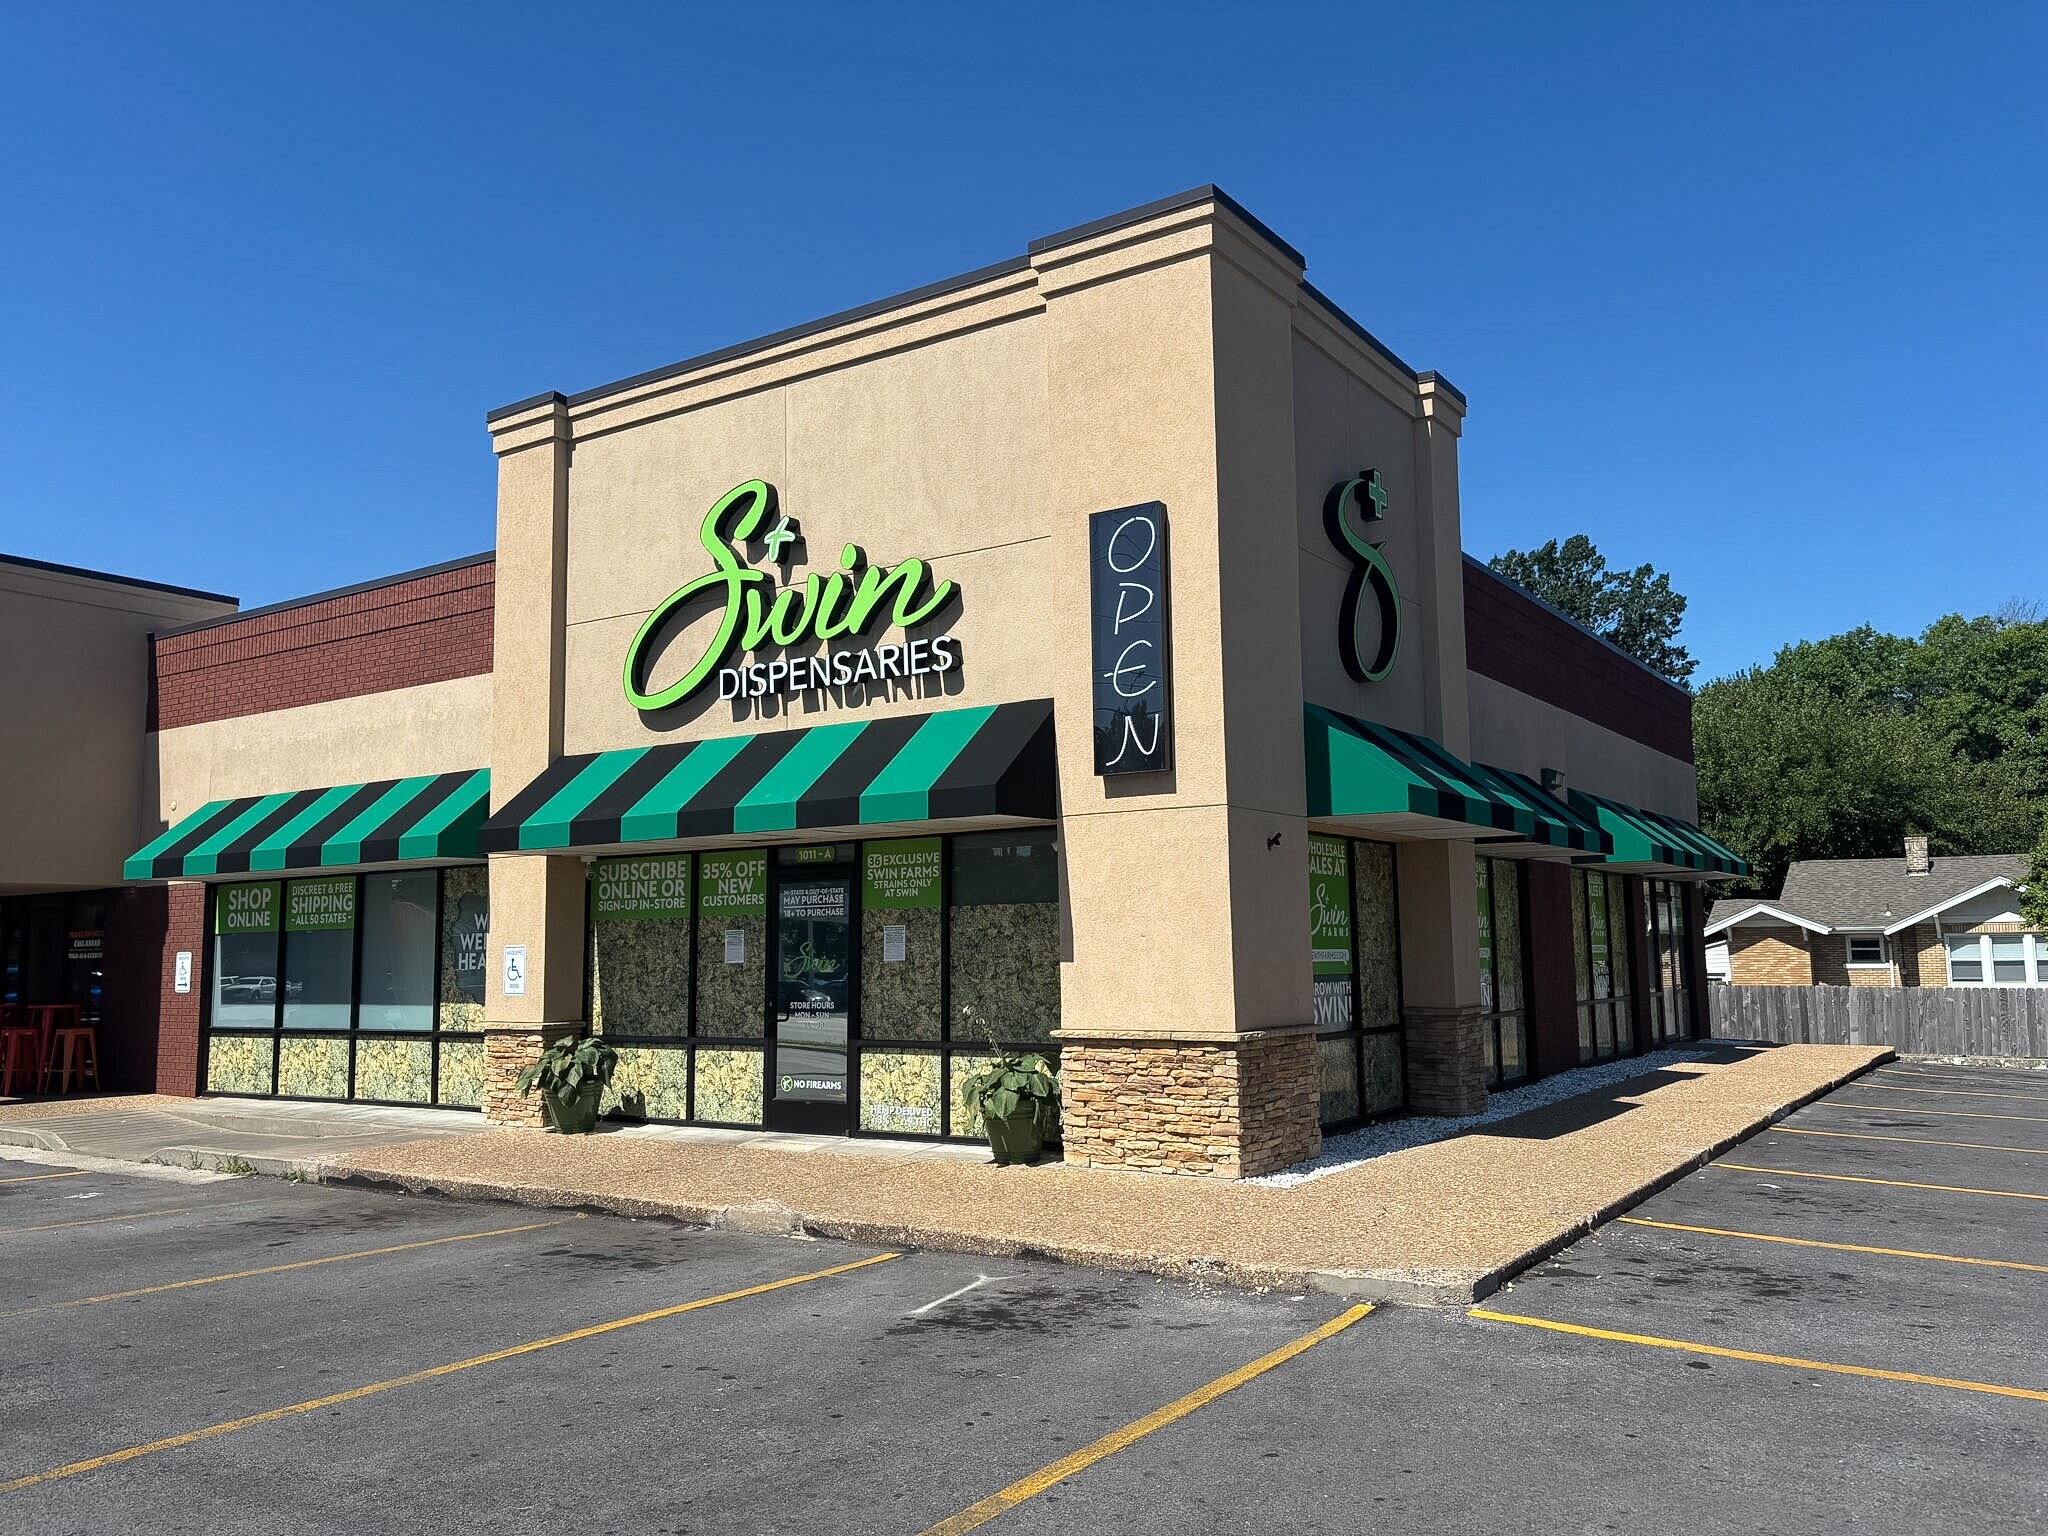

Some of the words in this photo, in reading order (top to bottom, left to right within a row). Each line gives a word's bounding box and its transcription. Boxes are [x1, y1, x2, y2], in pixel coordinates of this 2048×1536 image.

[623, 479, 954, 711] Swin
[1104, 516, 1159, 767] OPEN
[718, 635, 954, 701] DISPENSARIES
[799, 850, 817, 861] 1011
[824, 849, 832, 859] A
[1308, 841, 1345, 858] HOLESALE
[883, 852, 940, 866] EXCLUSIVE
[599, 860, 687, 882] SUBSCRIBE
[702, 862, 732, 880] 35%
[736, 860, 765, 877] OFF
[867, 868, 898, 880] SWIN
[900, 866, 940, 879] FARMS
[1310, 856, 1332, 875] ALES
[1334, 858, 1345, 877] AT
[292, 884, 327, 896] DISCREET
[335, 882, 353, 893] FREE
[598, 880, 657, 900] ONLINE
[661, 879, 686, 897] OR
[718, 877, 754, 895] NEW
[873, 879, 908, 889] STRAINS
[909, 878, 933, 888] ONLY
[228, 888, 272, 911] SHOP
[884, 889, 896, 898] AT
[896, 887, 919, 898] SWIN
[291, 893, 353, 915] SHIPPING
[598, 899, 637, 912] SIGN-UP
[639, 897, 686, 909] IN-STORE
[702, 894, 765, 907] CUSTOMERS
[783, 896, 801, 906] MAY
[801, 894, 844, 905] PURCHASE
[227, 911, 271, 928] ONLINE
[295, 914, 309, 926] ALL
[309, 914, 319, 925] 50
[319, 912, 347, 924] STATES
[783, 910, 796, 918] 18+
[796, 909, 806, 917] TO
[807, 907, 845, 917] PURCHASE
[1322, 927, 1349, 937] FARMS
[1312, 981, 1332, 997] ROW
[1332, 980, 1352, 995] WITH
[789, 1002, 811, 1010] STORE
[811, 1002, 835, 1010] HOURS
[794, 1011, 811, 1019] MON
[815, 1011, 830, 1019] SUN
[794, 1079, 805, 1089] NO
[806, 1080, 842, 1090] FIREARMS
[870, 1104, 896, 1116] HEMP
[895, 1106, 933, 1117] DERIVED
